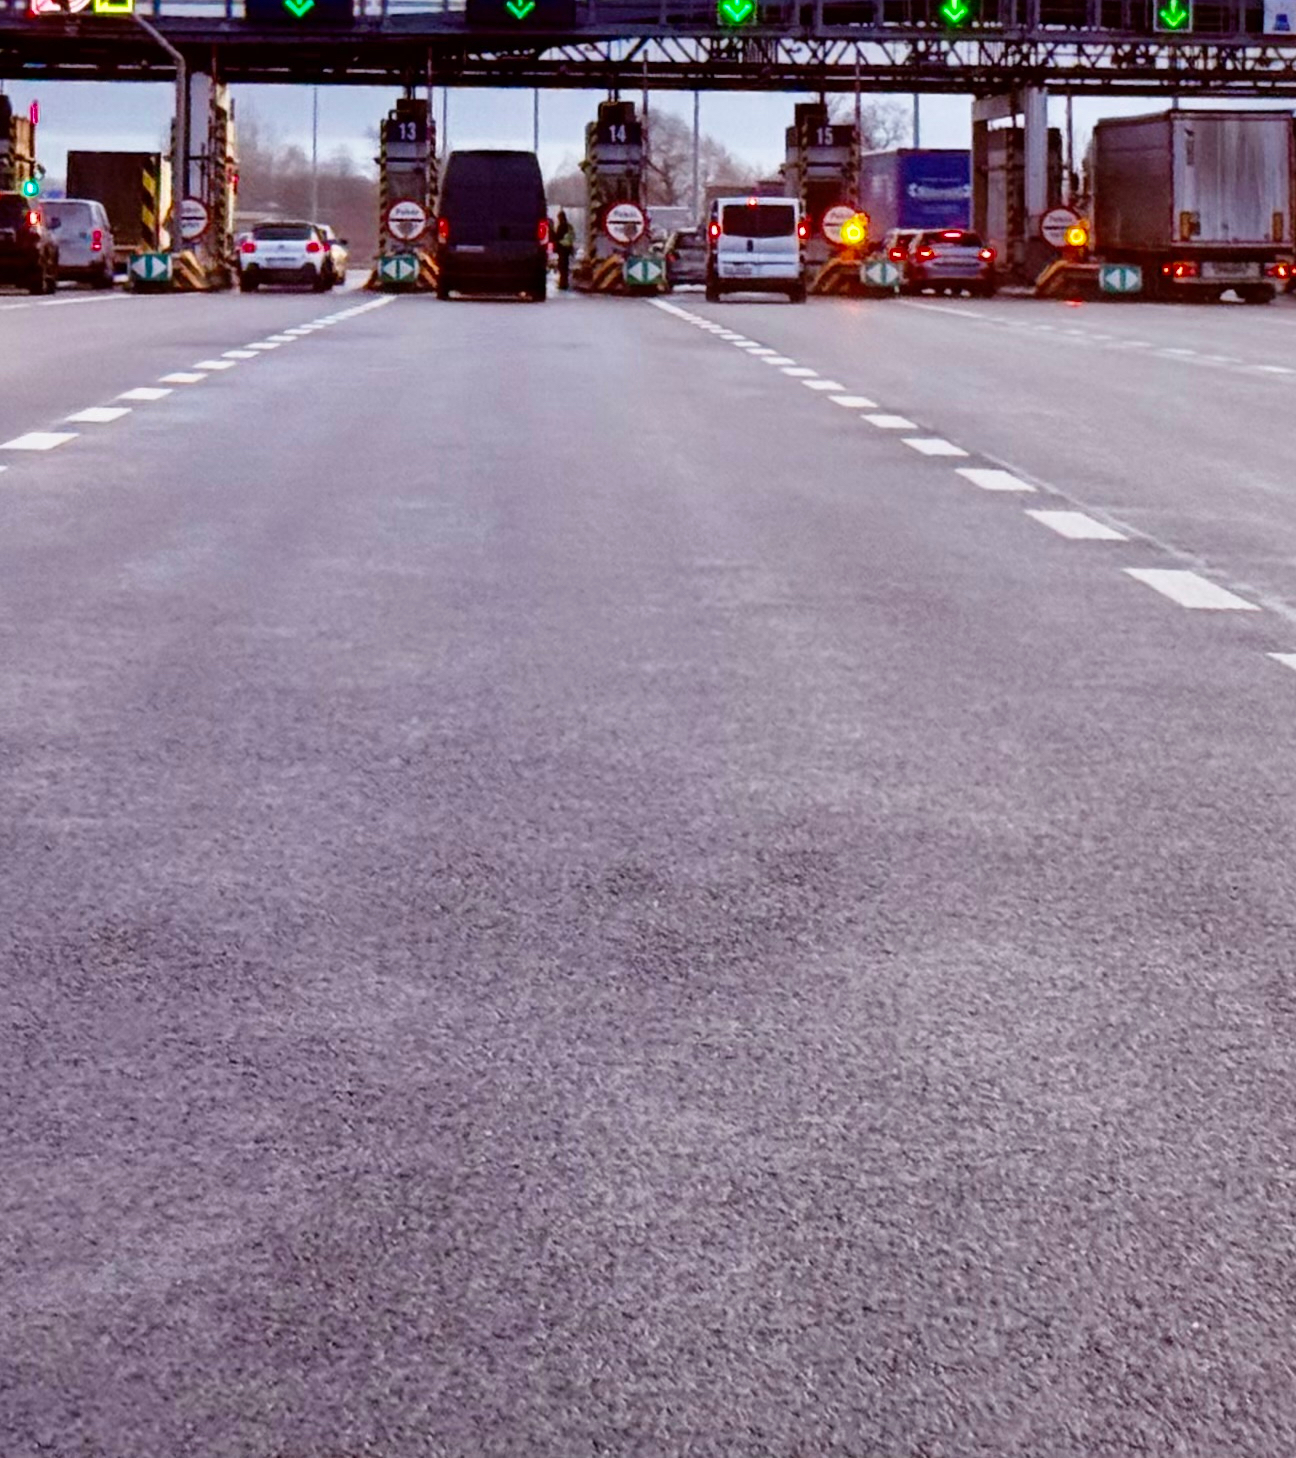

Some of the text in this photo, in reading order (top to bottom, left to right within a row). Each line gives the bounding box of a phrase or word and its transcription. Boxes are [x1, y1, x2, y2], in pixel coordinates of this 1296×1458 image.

[399, 122, 417, 141] 13
[609, 124, 627, 143] 14
[816, 127, 834, 145] 15
